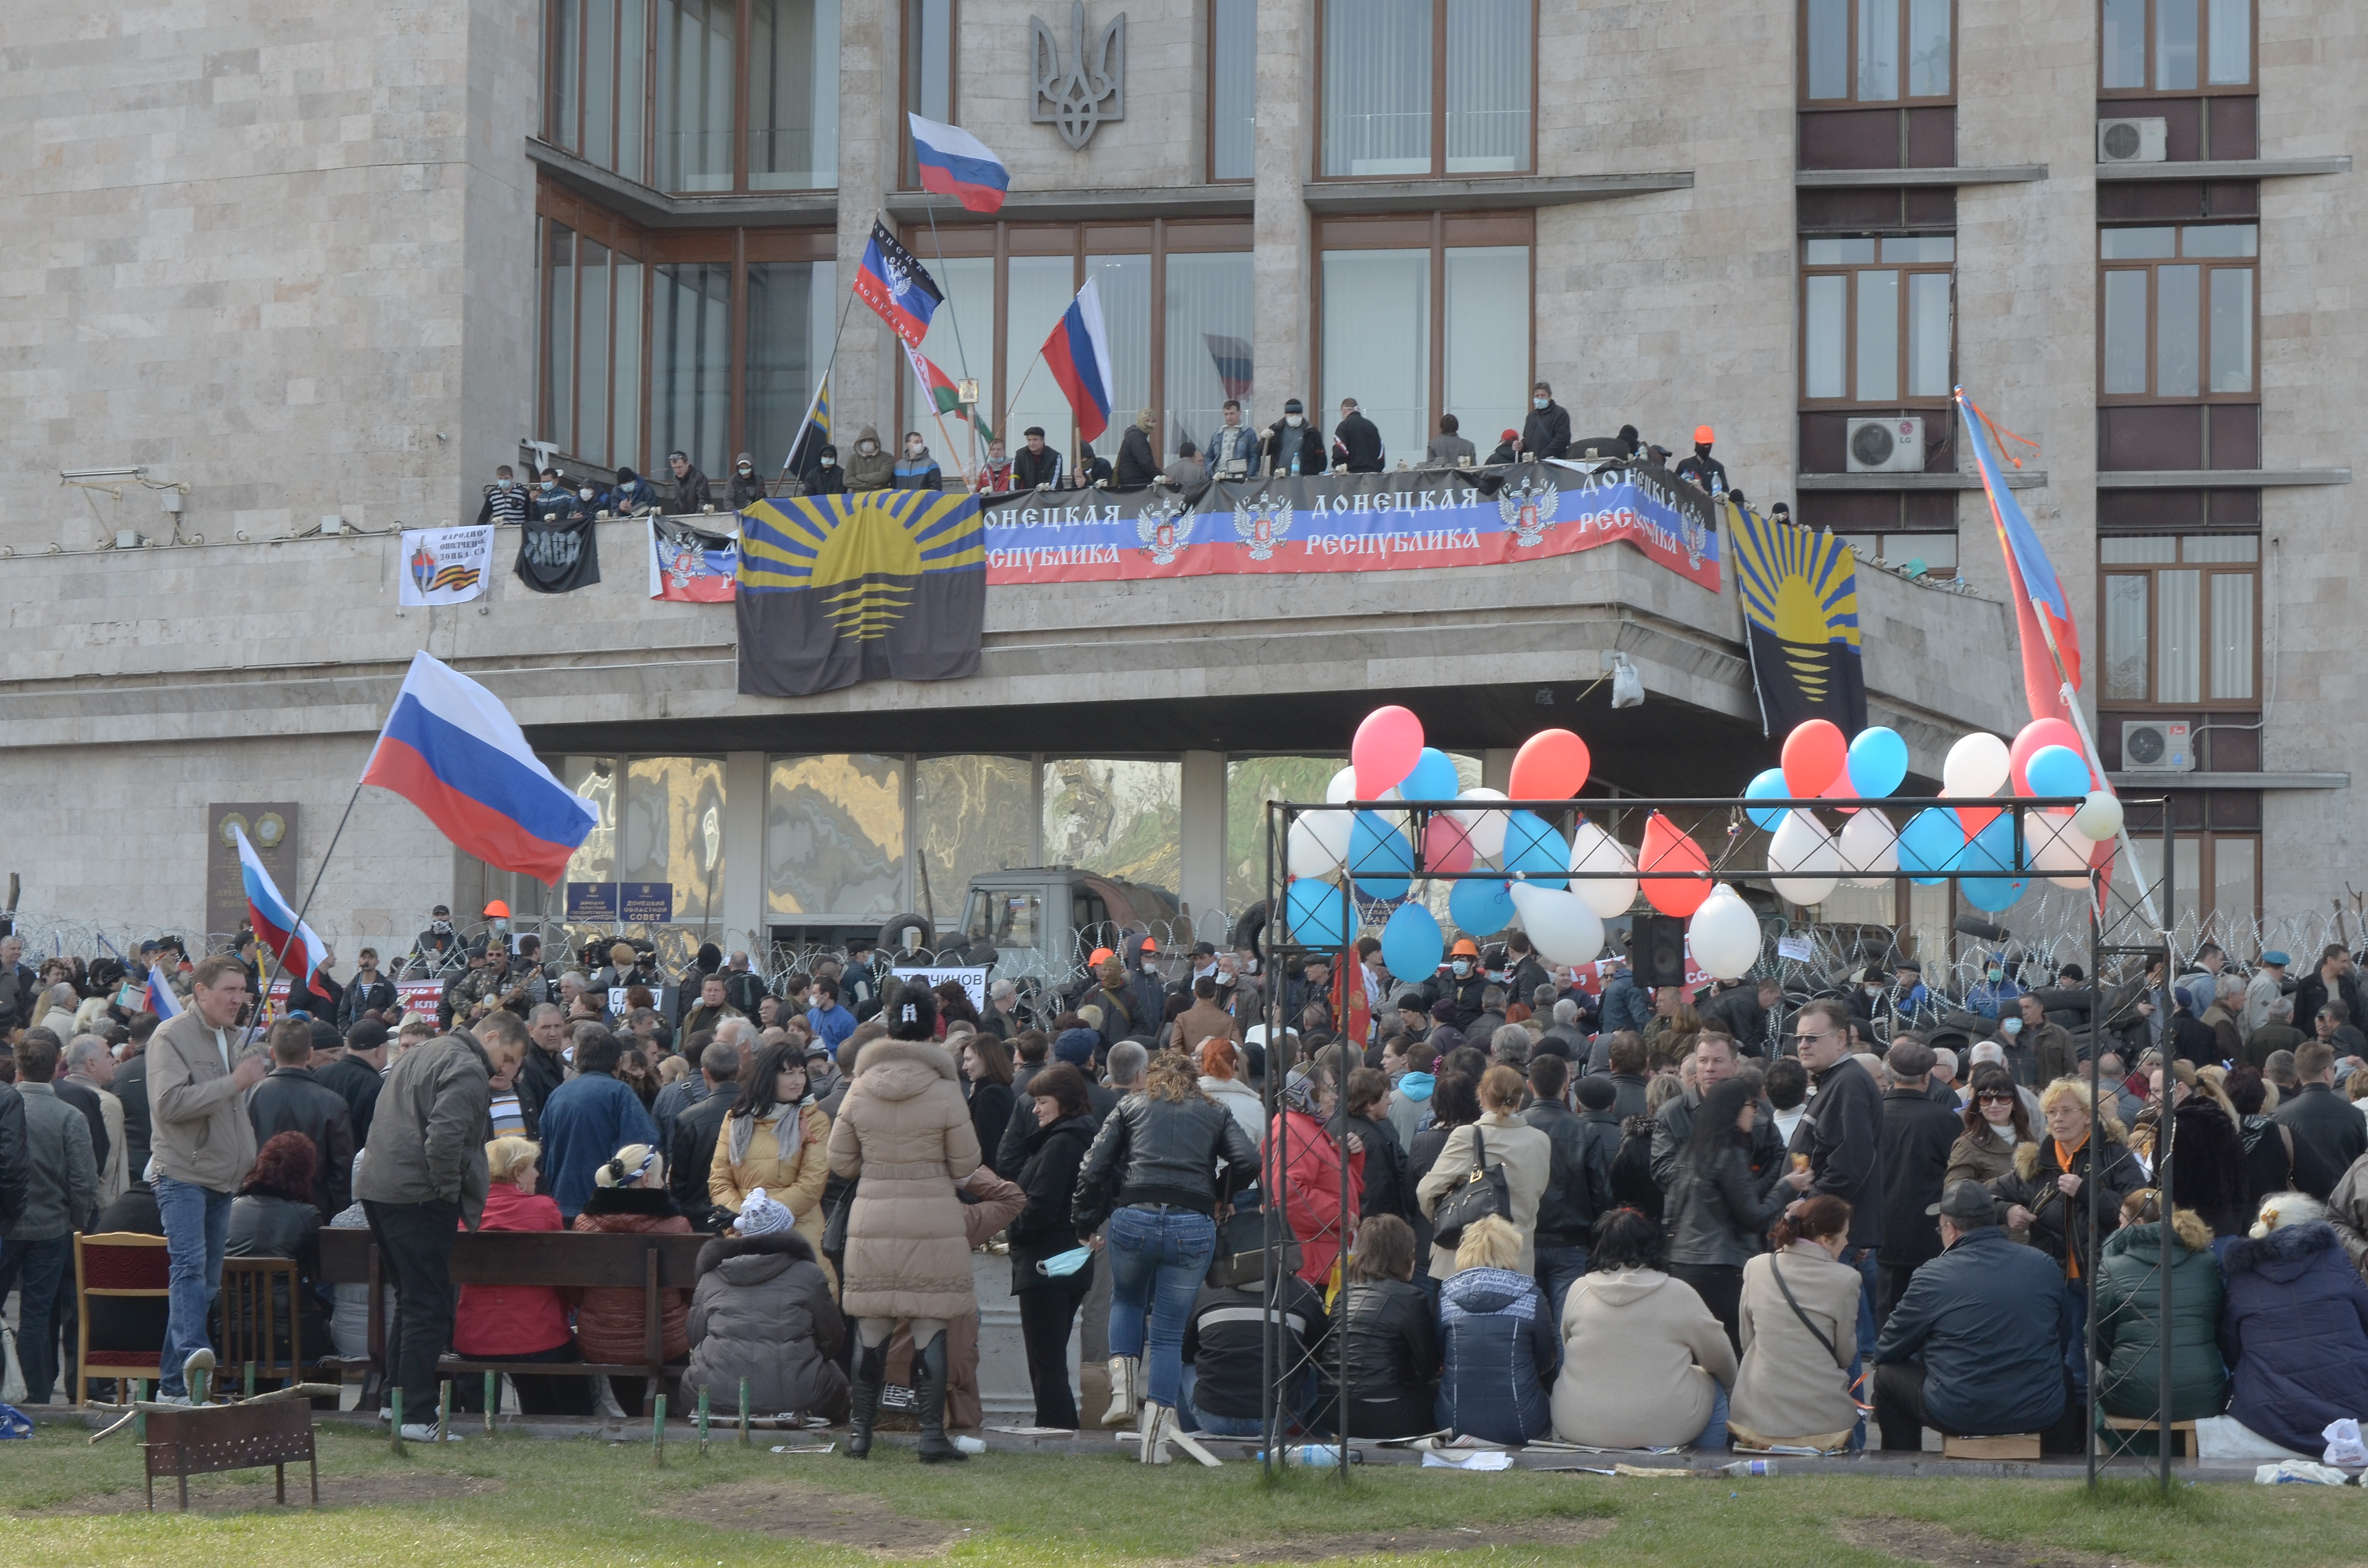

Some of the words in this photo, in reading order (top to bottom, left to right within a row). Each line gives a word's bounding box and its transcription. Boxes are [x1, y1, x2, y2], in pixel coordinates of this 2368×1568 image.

[983, 505, 1121, 533] ОНЕЦКАЯ
[1311, 488, 1479, 520] ДОНЕЦКАЯ
[985, 543, 1121, 573] СПУБЛИКА
[1304, 527, 1481, 560] РЕСПУБЛИКА
